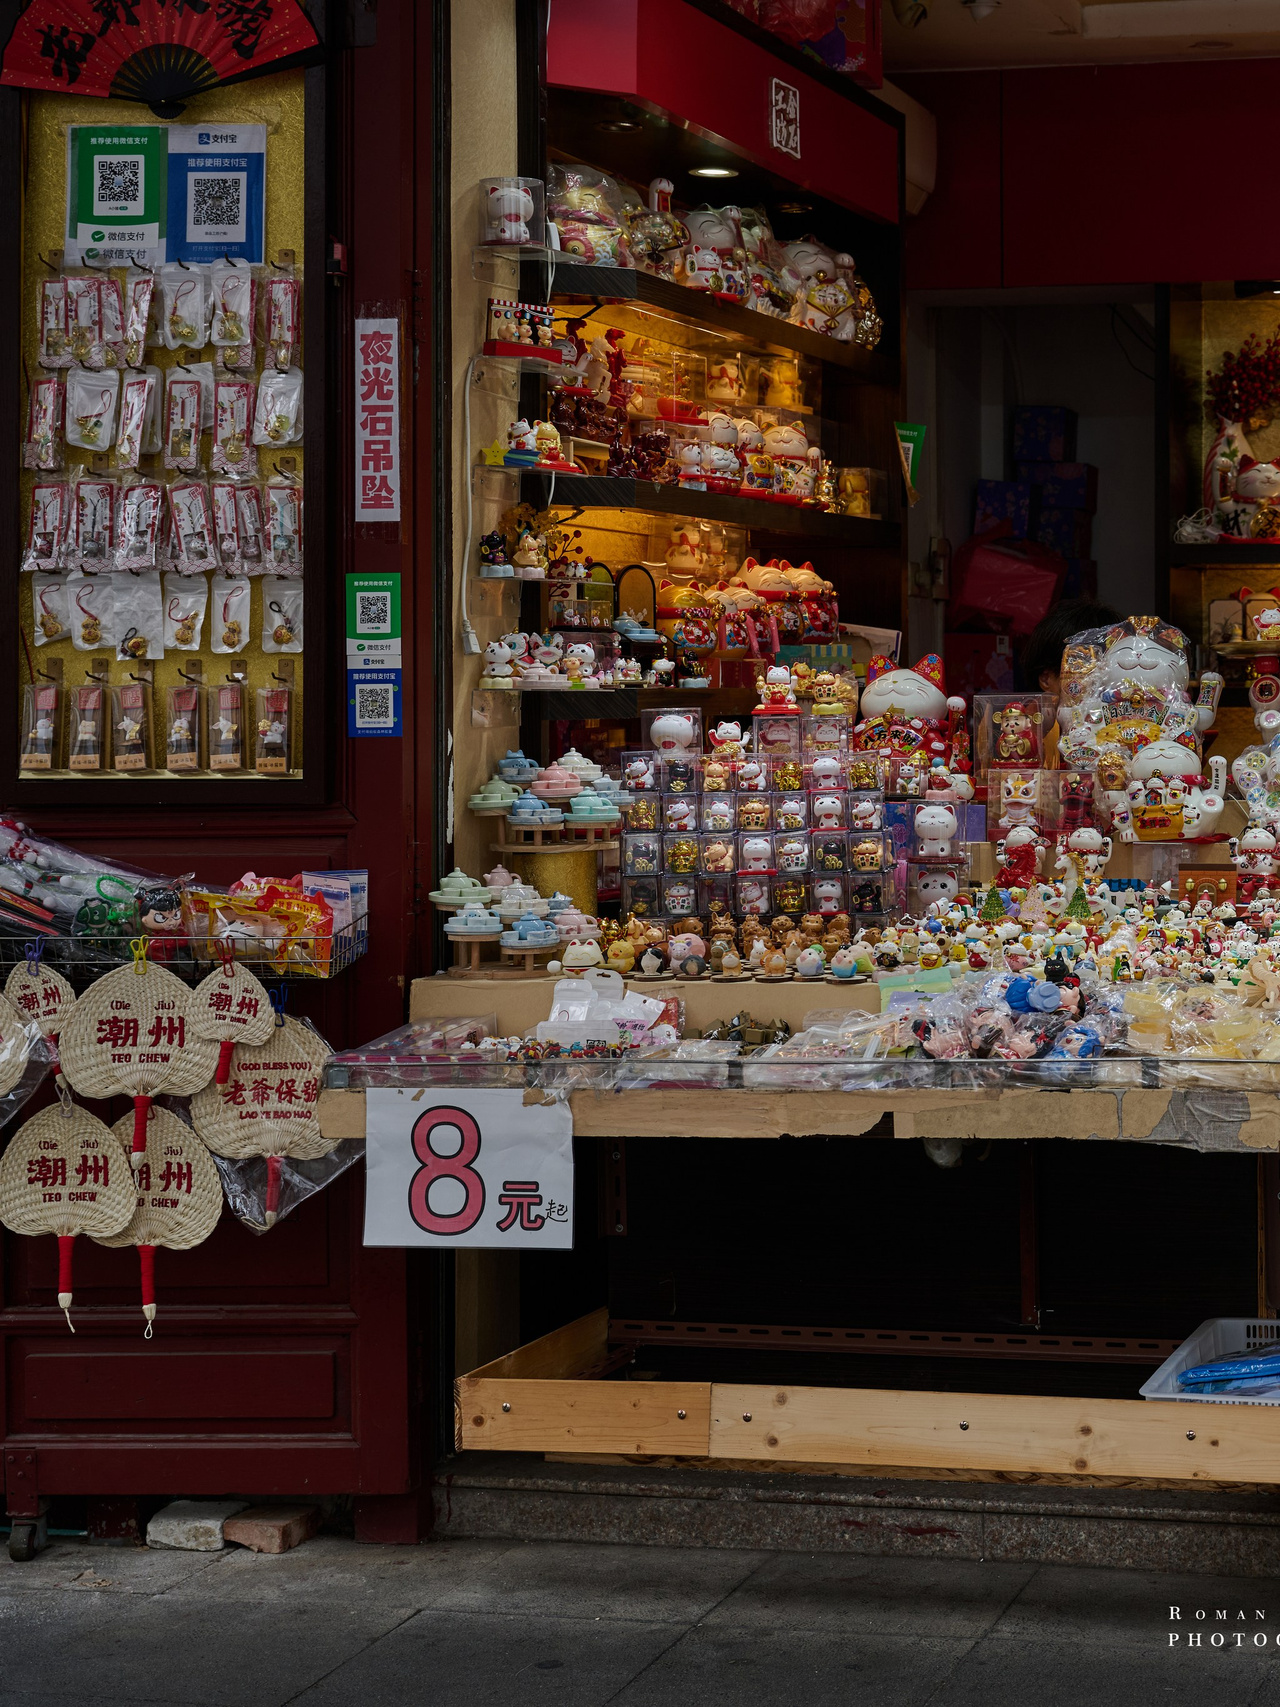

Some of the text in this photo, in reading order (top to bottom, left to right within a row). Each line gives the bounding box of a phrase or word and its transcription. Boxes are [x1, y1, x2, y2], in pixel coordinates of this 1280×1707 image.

[90, 137, 148, 145] 推荐使用微信支付
[211, 134, 237, 144] 支付宝
[187, 158, 248, 168] 推荐使用支付宝
[107, 231, 145, 242] 微信支付
[102, 249, 147, 260] 微信支付
[359, 330, 396, 510] 夜光石吊坠
[17, 985, 62, 1012] 潮州
[110, 1000, 175, 1011] (Die Jiu)
[208, 992, 259, 1018] 潮州
[96, 1015, 185, 1049] 潮州
[111, 1053, 170, 1063] TEO CHEW
[237, 1061, 312, 1072] (GOD BLESS YOU)
[240, 1110, 258, 1120] LAO
[273, 1110, 292, 1120] BAO
[293, 1110, 312, 1120] HAO
[38, 1139, 99, 1150] (Die Jiu)
[27, 1154, 109, 1188] 潮州
[42, 1191, 97, 1203] TEO CHEW
[151, 1197, 179, 1208] CHEW
